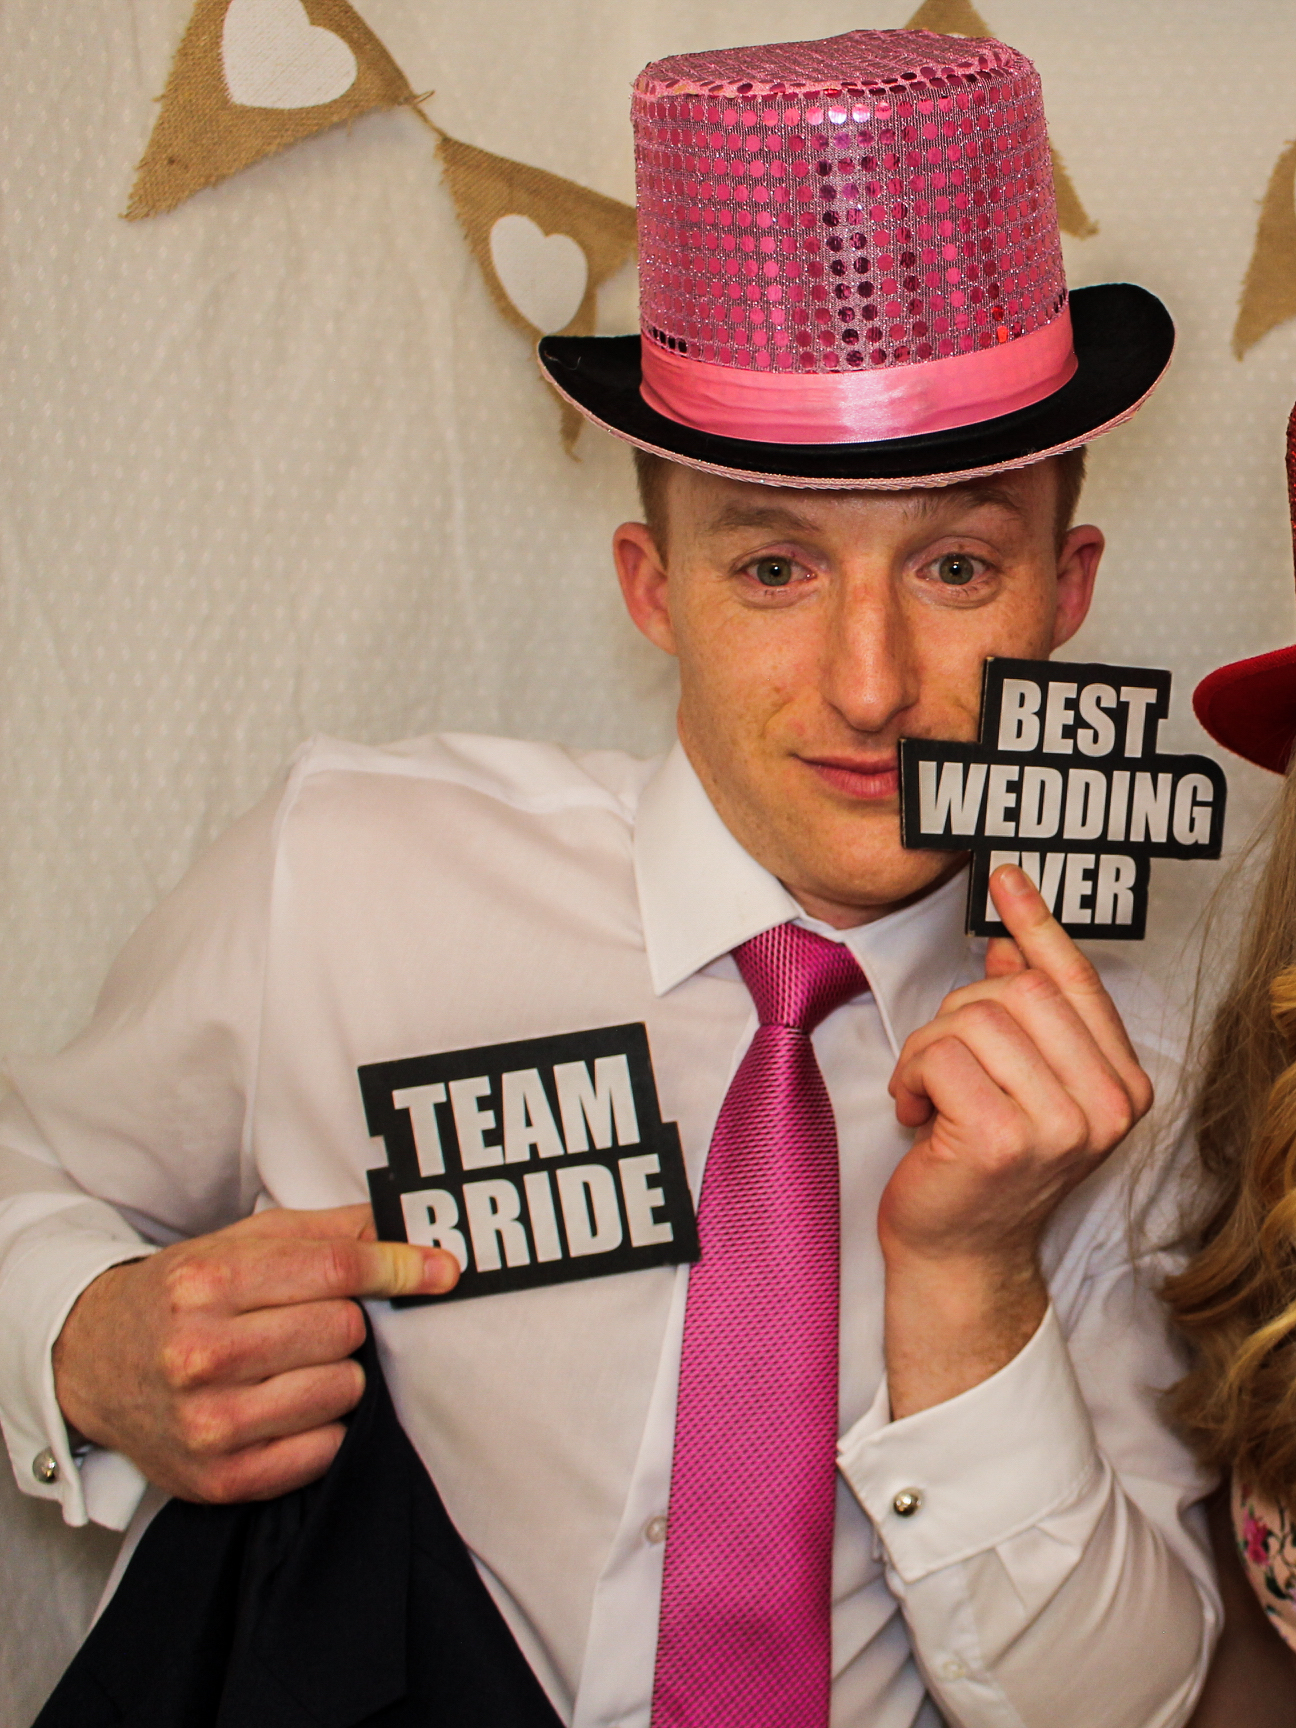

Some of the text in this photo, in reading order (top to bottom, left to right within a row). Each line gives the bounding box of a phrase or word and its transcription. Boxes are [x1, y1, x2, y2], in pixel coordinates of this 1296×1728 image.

[997, 678, 1157, 758] BEST
[918, 760, 1214, 845] WEDDING
[392, 1053, 640, 1178] TEAM
[399, 1152, 674, 1274] BRIDE
